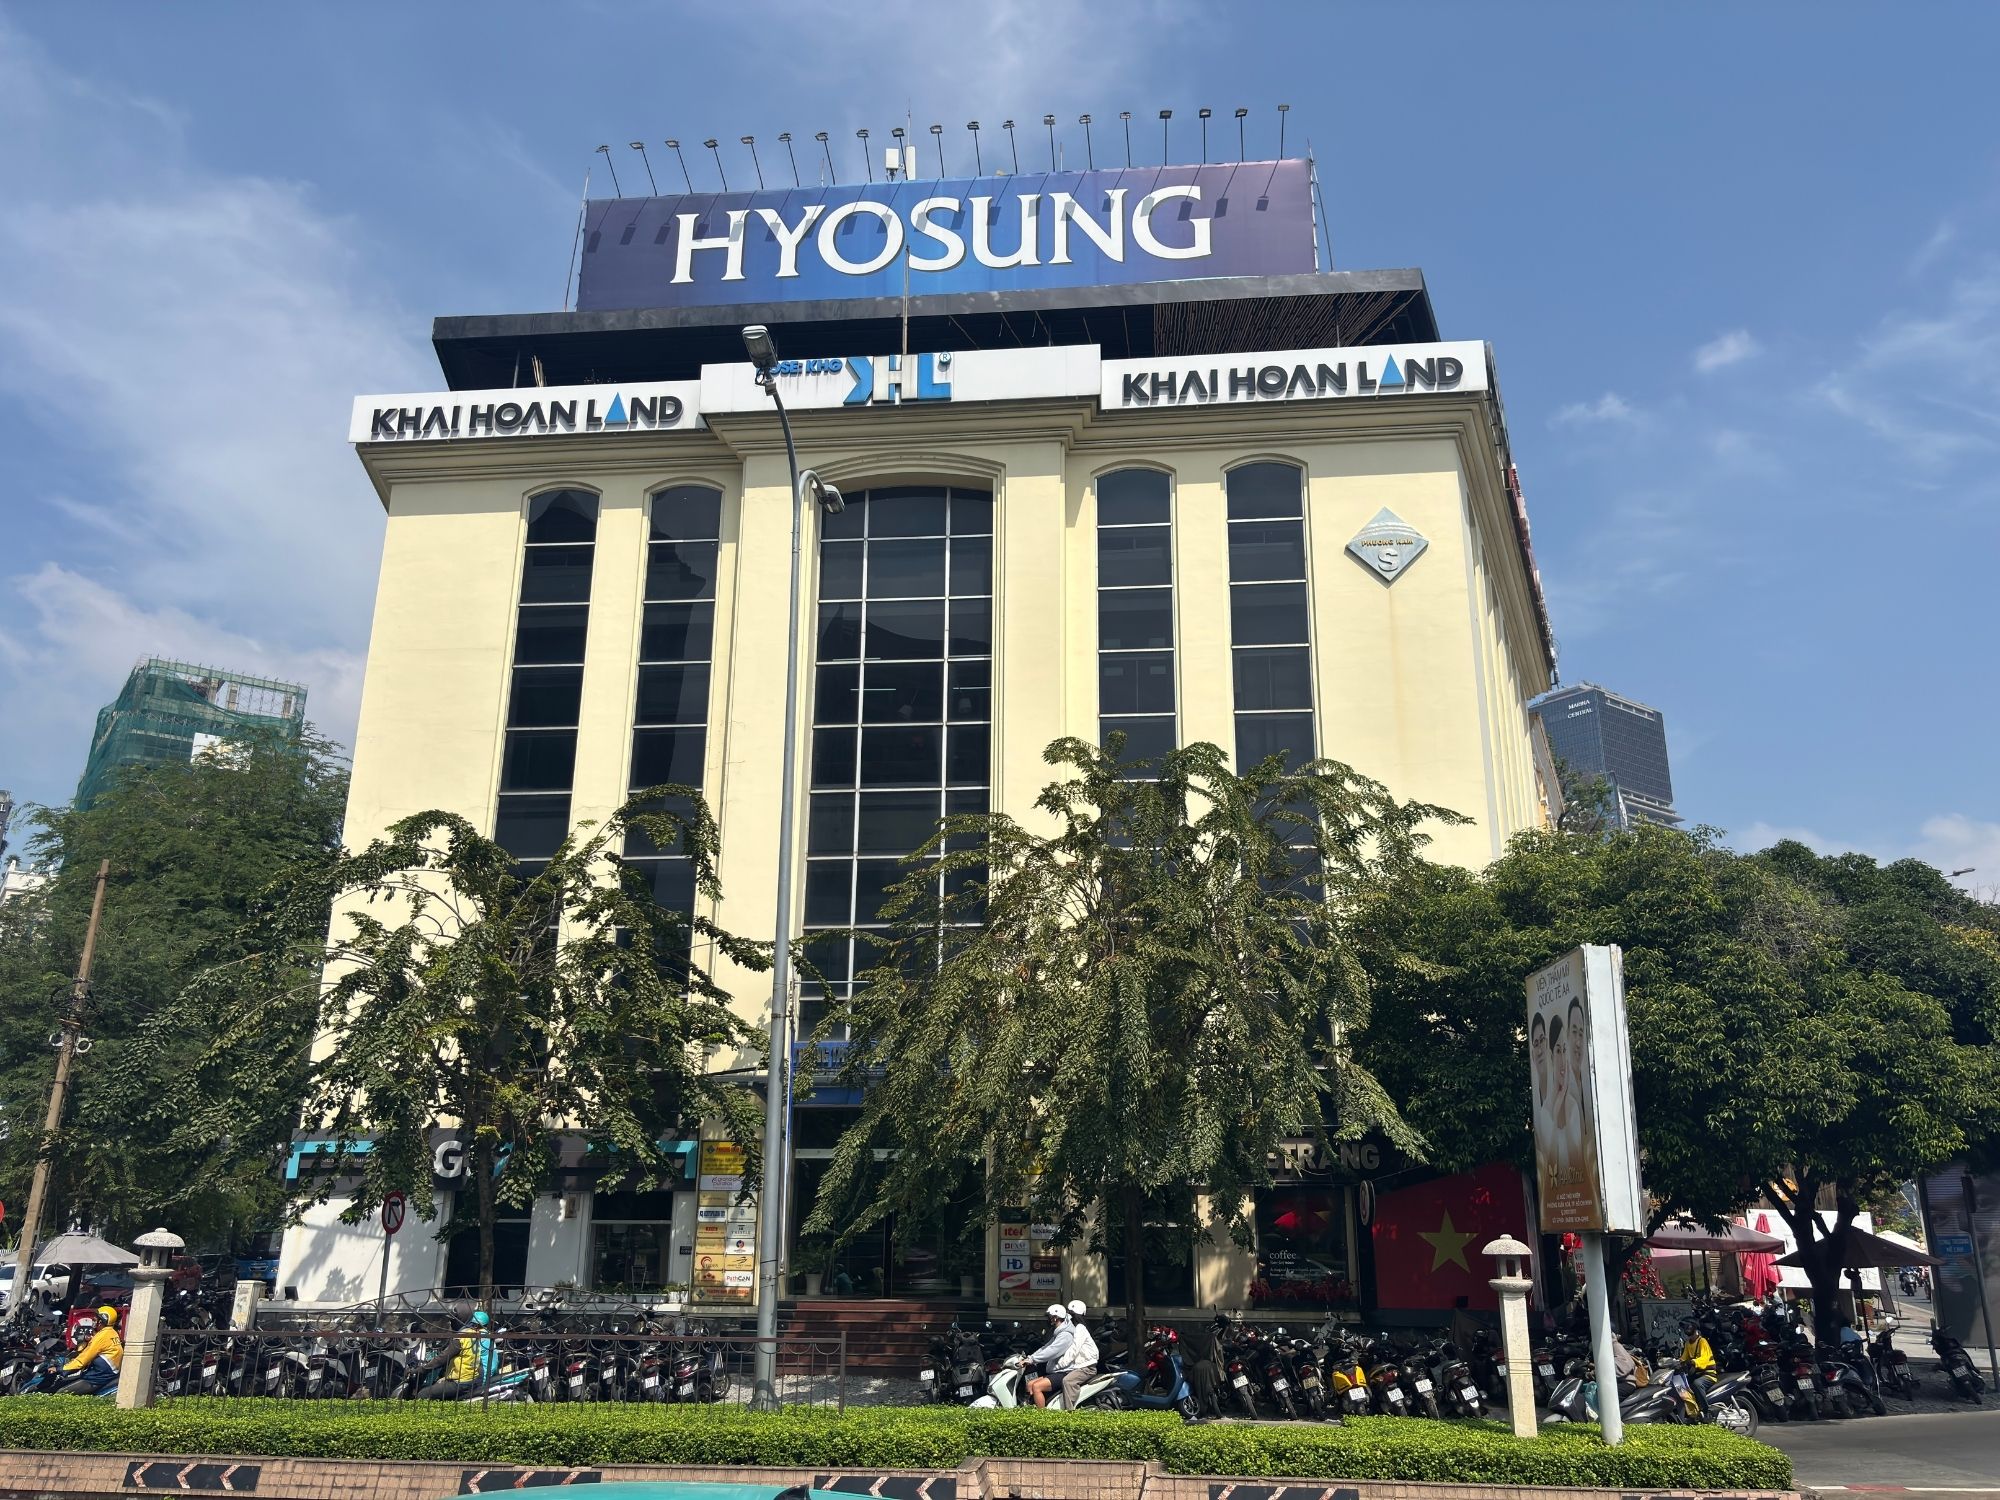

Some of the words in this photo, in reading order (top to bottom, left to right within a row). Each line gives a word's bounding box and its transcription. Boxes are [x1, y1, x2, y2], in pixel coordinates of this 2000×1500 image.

[670, 184, 1213, 284] HYOSUNG
[757, 361, 803, 376] OSE:
[806, 358, 843, 374] KHG
[1122, 367, 1219, 402] KHAI
[1229, 361, 1348, 397] HOAN
[1357, 352, 1464, 389] LAND
[371, 404, 462, 436] KHAI
[468, 398, 578, 431] HOAN
[586, 391, 684, 425] LAND
[1377, 548, 1399, 572] S
[1567, 707, 1593, 719] CENTRAL
[1568, 699, 1591, 710] MARINA
[1269, 1249, 1297, 1260] coffee
